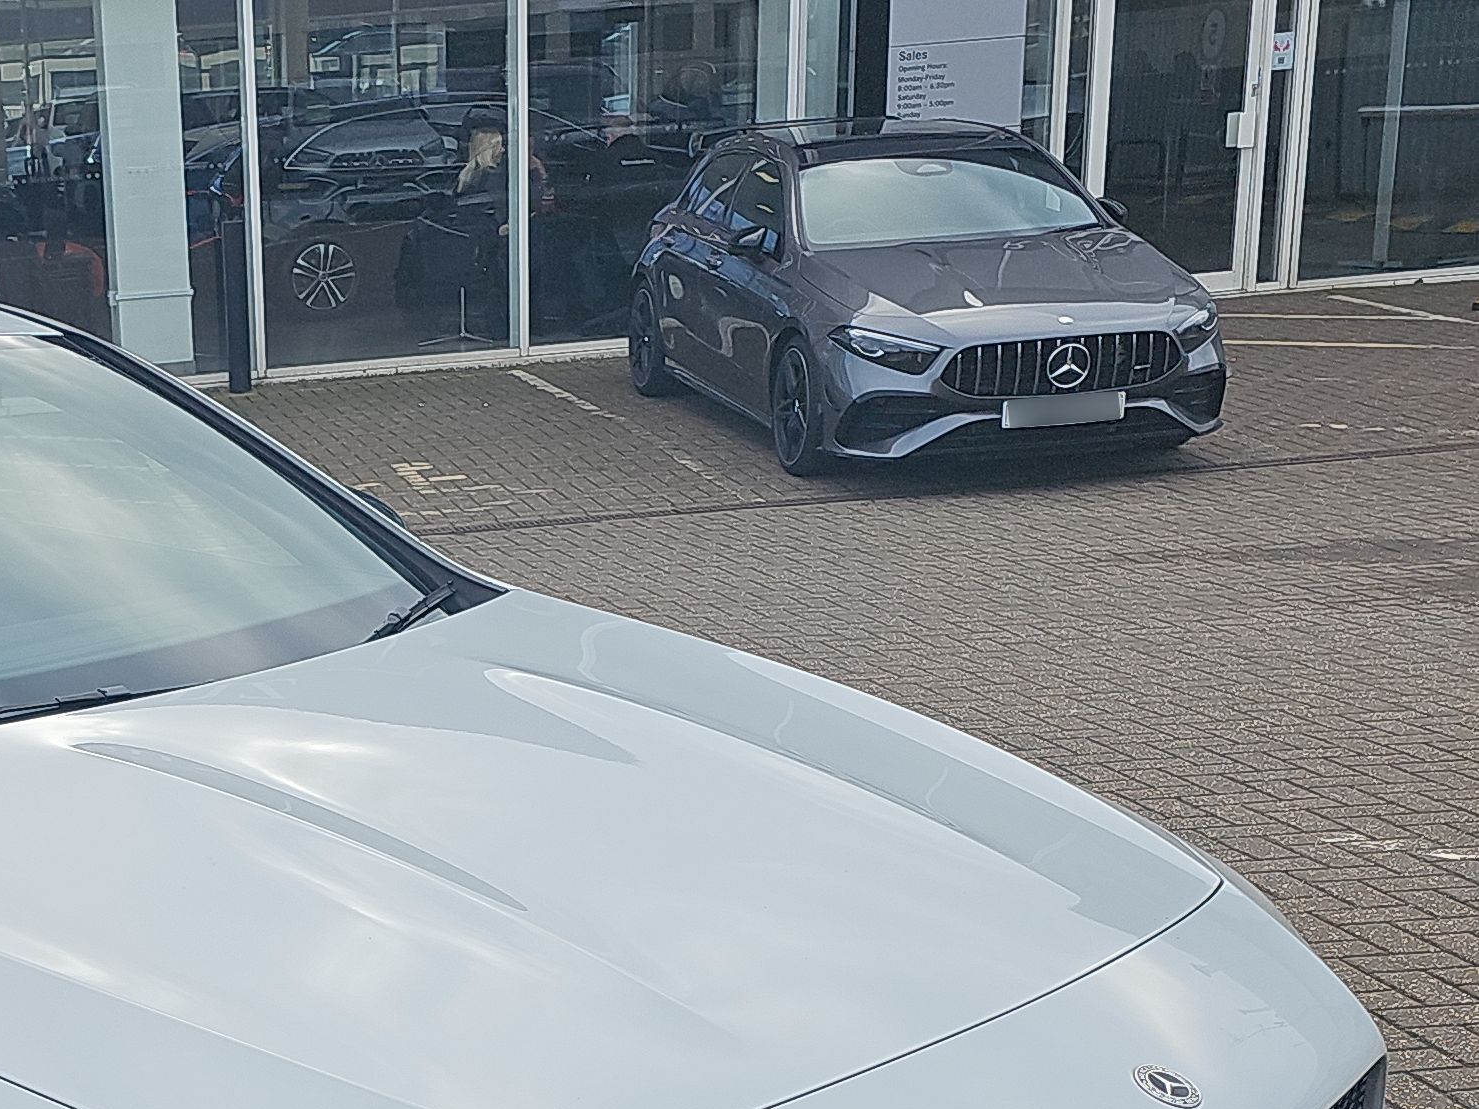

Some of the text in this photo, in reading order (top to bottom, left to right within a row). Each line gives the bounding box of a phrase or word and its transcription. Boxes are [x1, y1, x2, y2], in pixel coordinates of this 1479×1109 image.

[898, 50, 928, 62] Sales
[898, 65, 926, 73] Opening
[897, 93, 927, 102] Saturday
